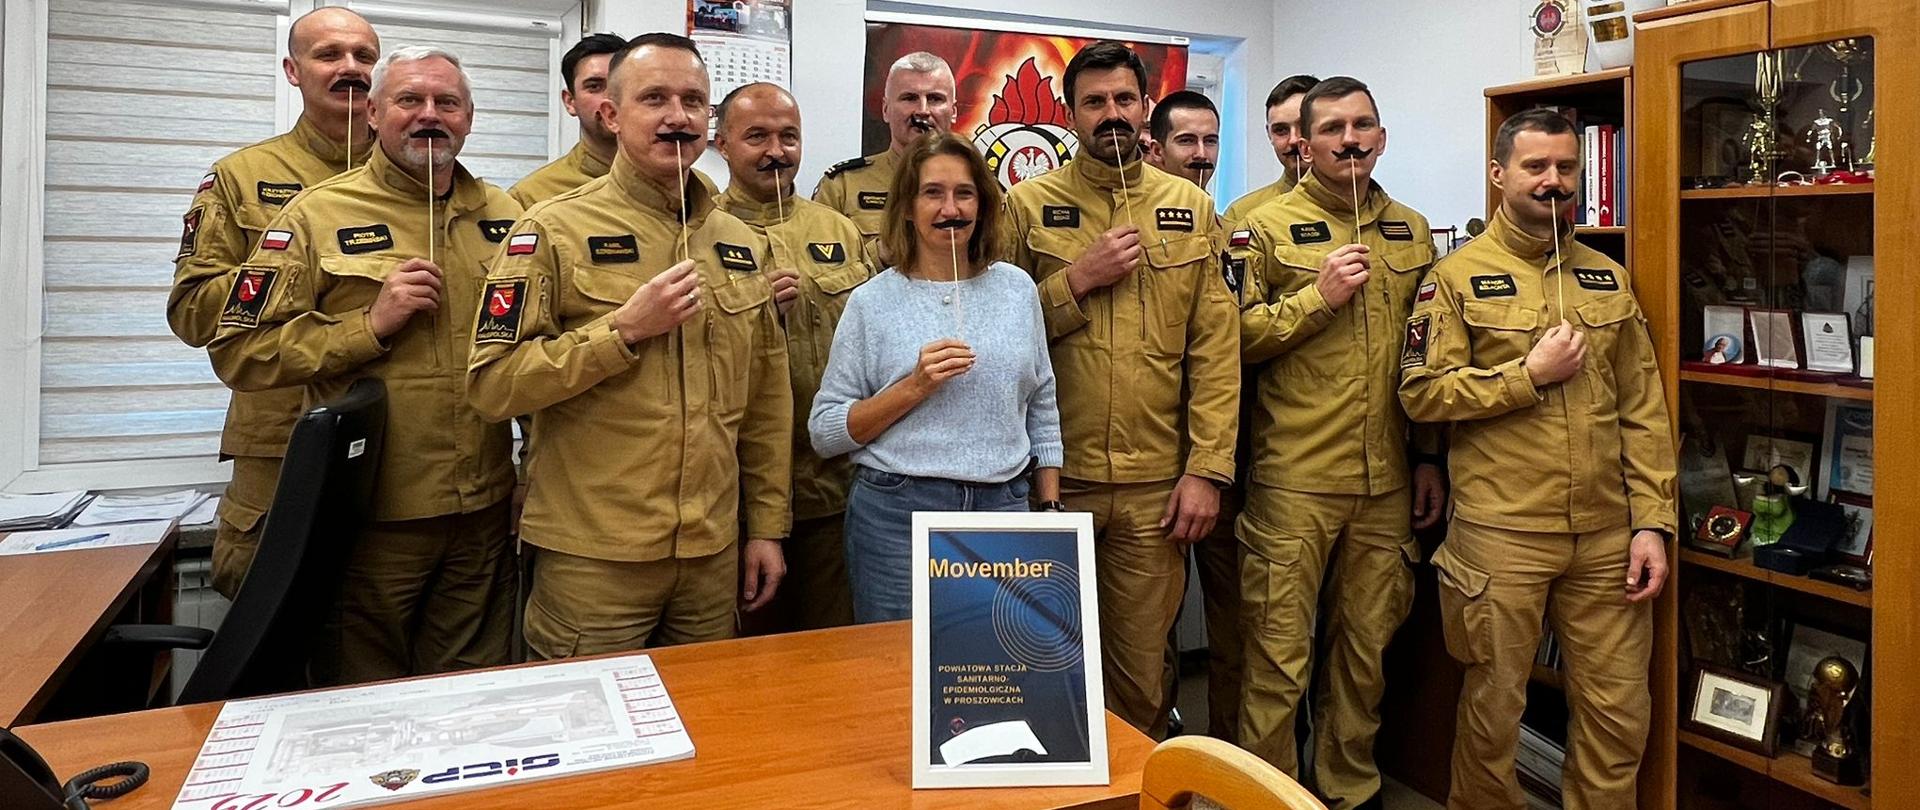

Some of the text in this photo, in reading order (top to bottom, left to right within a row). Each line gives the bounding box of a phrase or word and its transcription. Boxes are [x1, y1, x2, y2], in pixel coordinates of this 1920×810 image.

[929, 558, 1053, 578] Movember
[938, 664, 1027, 673] POWIATOWA STACJA
[956, 674, 1009, 683] SANITARNO-
[944, 696, 1024, 705] W PROSZOWICACH
